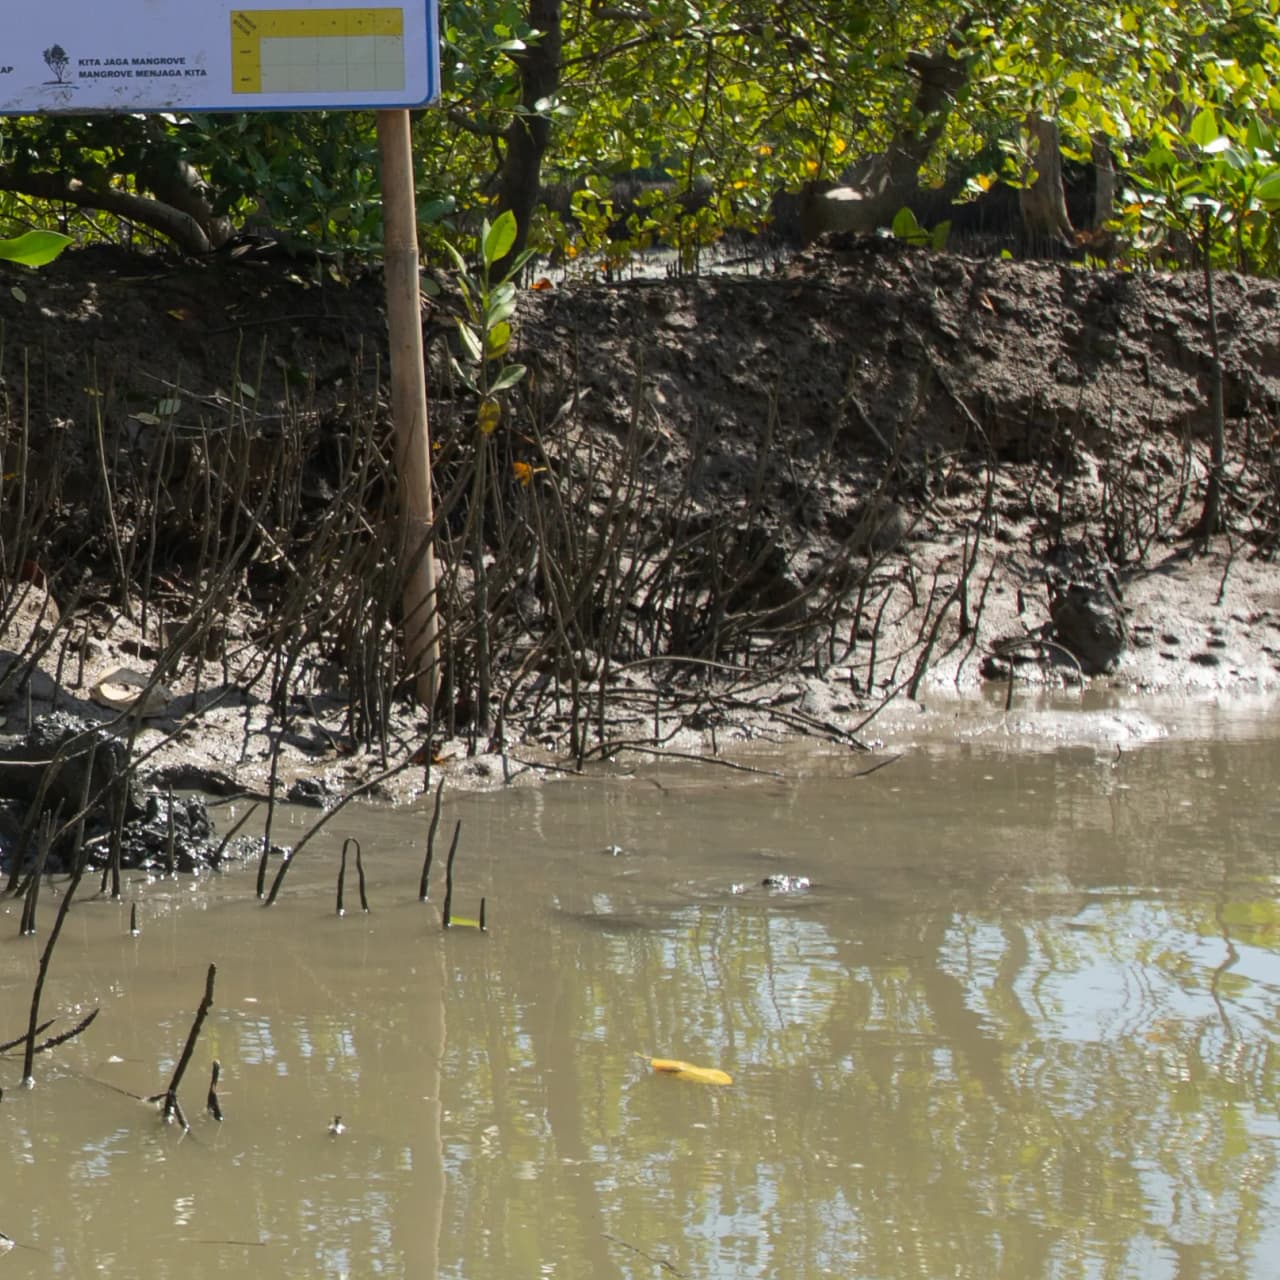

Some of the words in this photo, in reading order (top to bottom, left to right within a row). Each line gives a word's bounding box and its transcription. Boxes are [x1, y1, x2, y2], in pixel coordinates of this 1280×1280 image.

[78, 58, 101, 67] KITA
[103, 58, 129, 66] JAGA
[131, 57, 185, 66] MANGROVE
[78, 70, 133, 79] MANGROVE
[135, 69, 182, 78] MENJAGA
[184, 68, 207, 77] KITA
